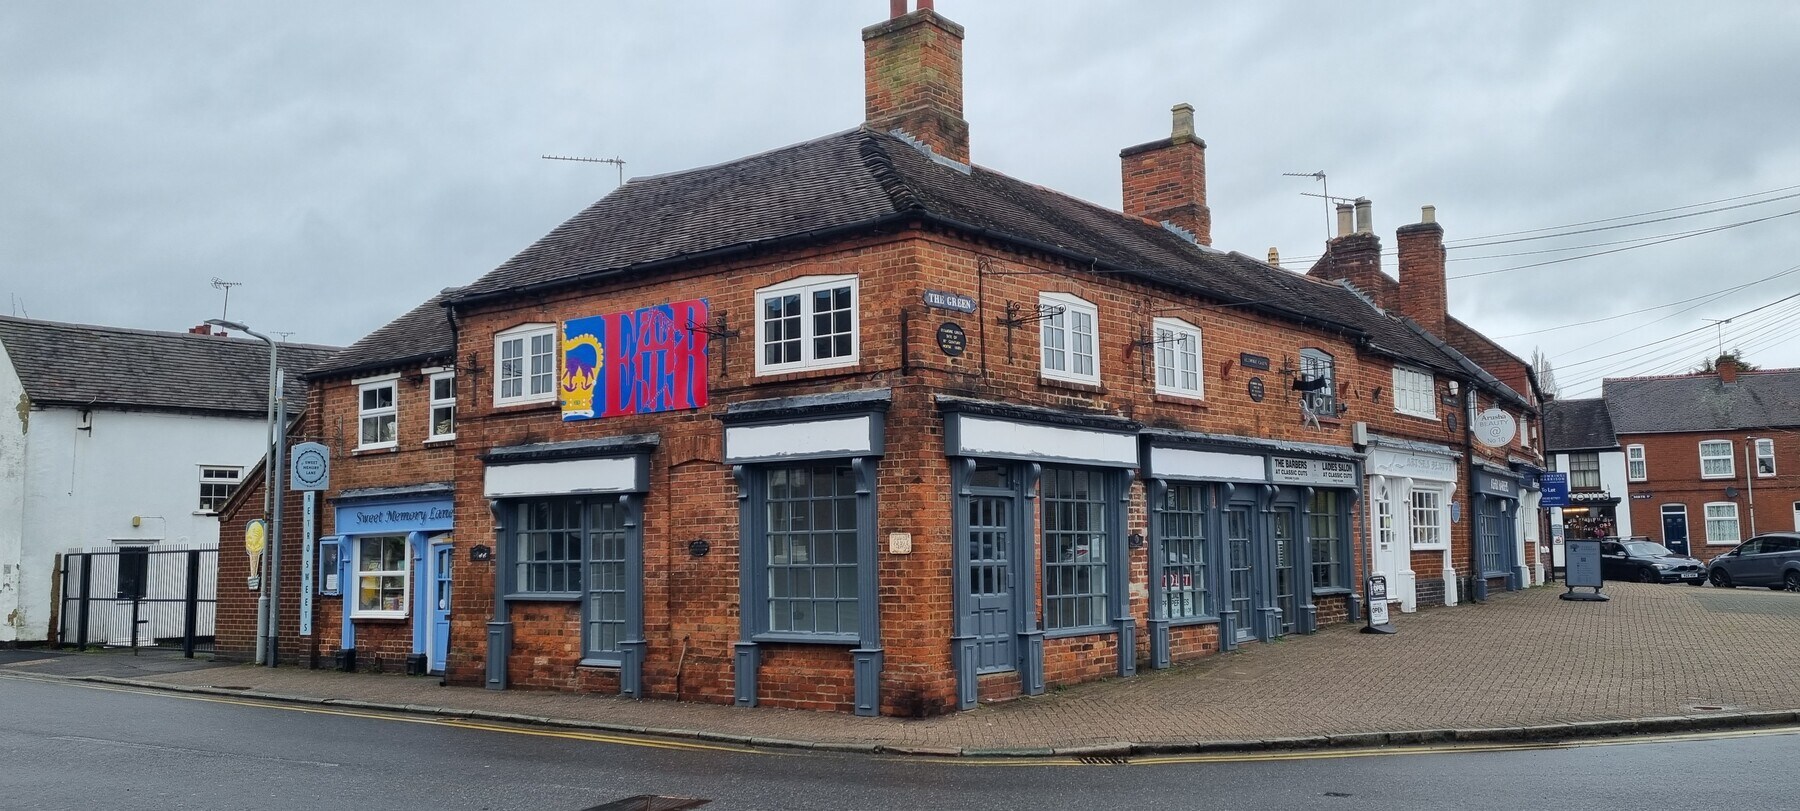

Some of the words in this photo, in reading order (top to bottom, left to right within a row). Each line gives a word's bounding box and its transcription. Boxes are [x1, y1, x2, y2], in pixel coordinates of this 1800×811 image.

[929, 293, 945, 305] THE
[947, 296, 971, 309] GREEN
[1490, 426, 1502, 437] @
[1275, 459, 1284, 468] THE
[1286, 460, 1308, 470] BARBERS
[1322, 462, 1338, 471] LADIES
[1338, 463, 1352, 472] SALON
[356, 512, 383, 524] Sweet
[385, 510, 426, 526] Memory
